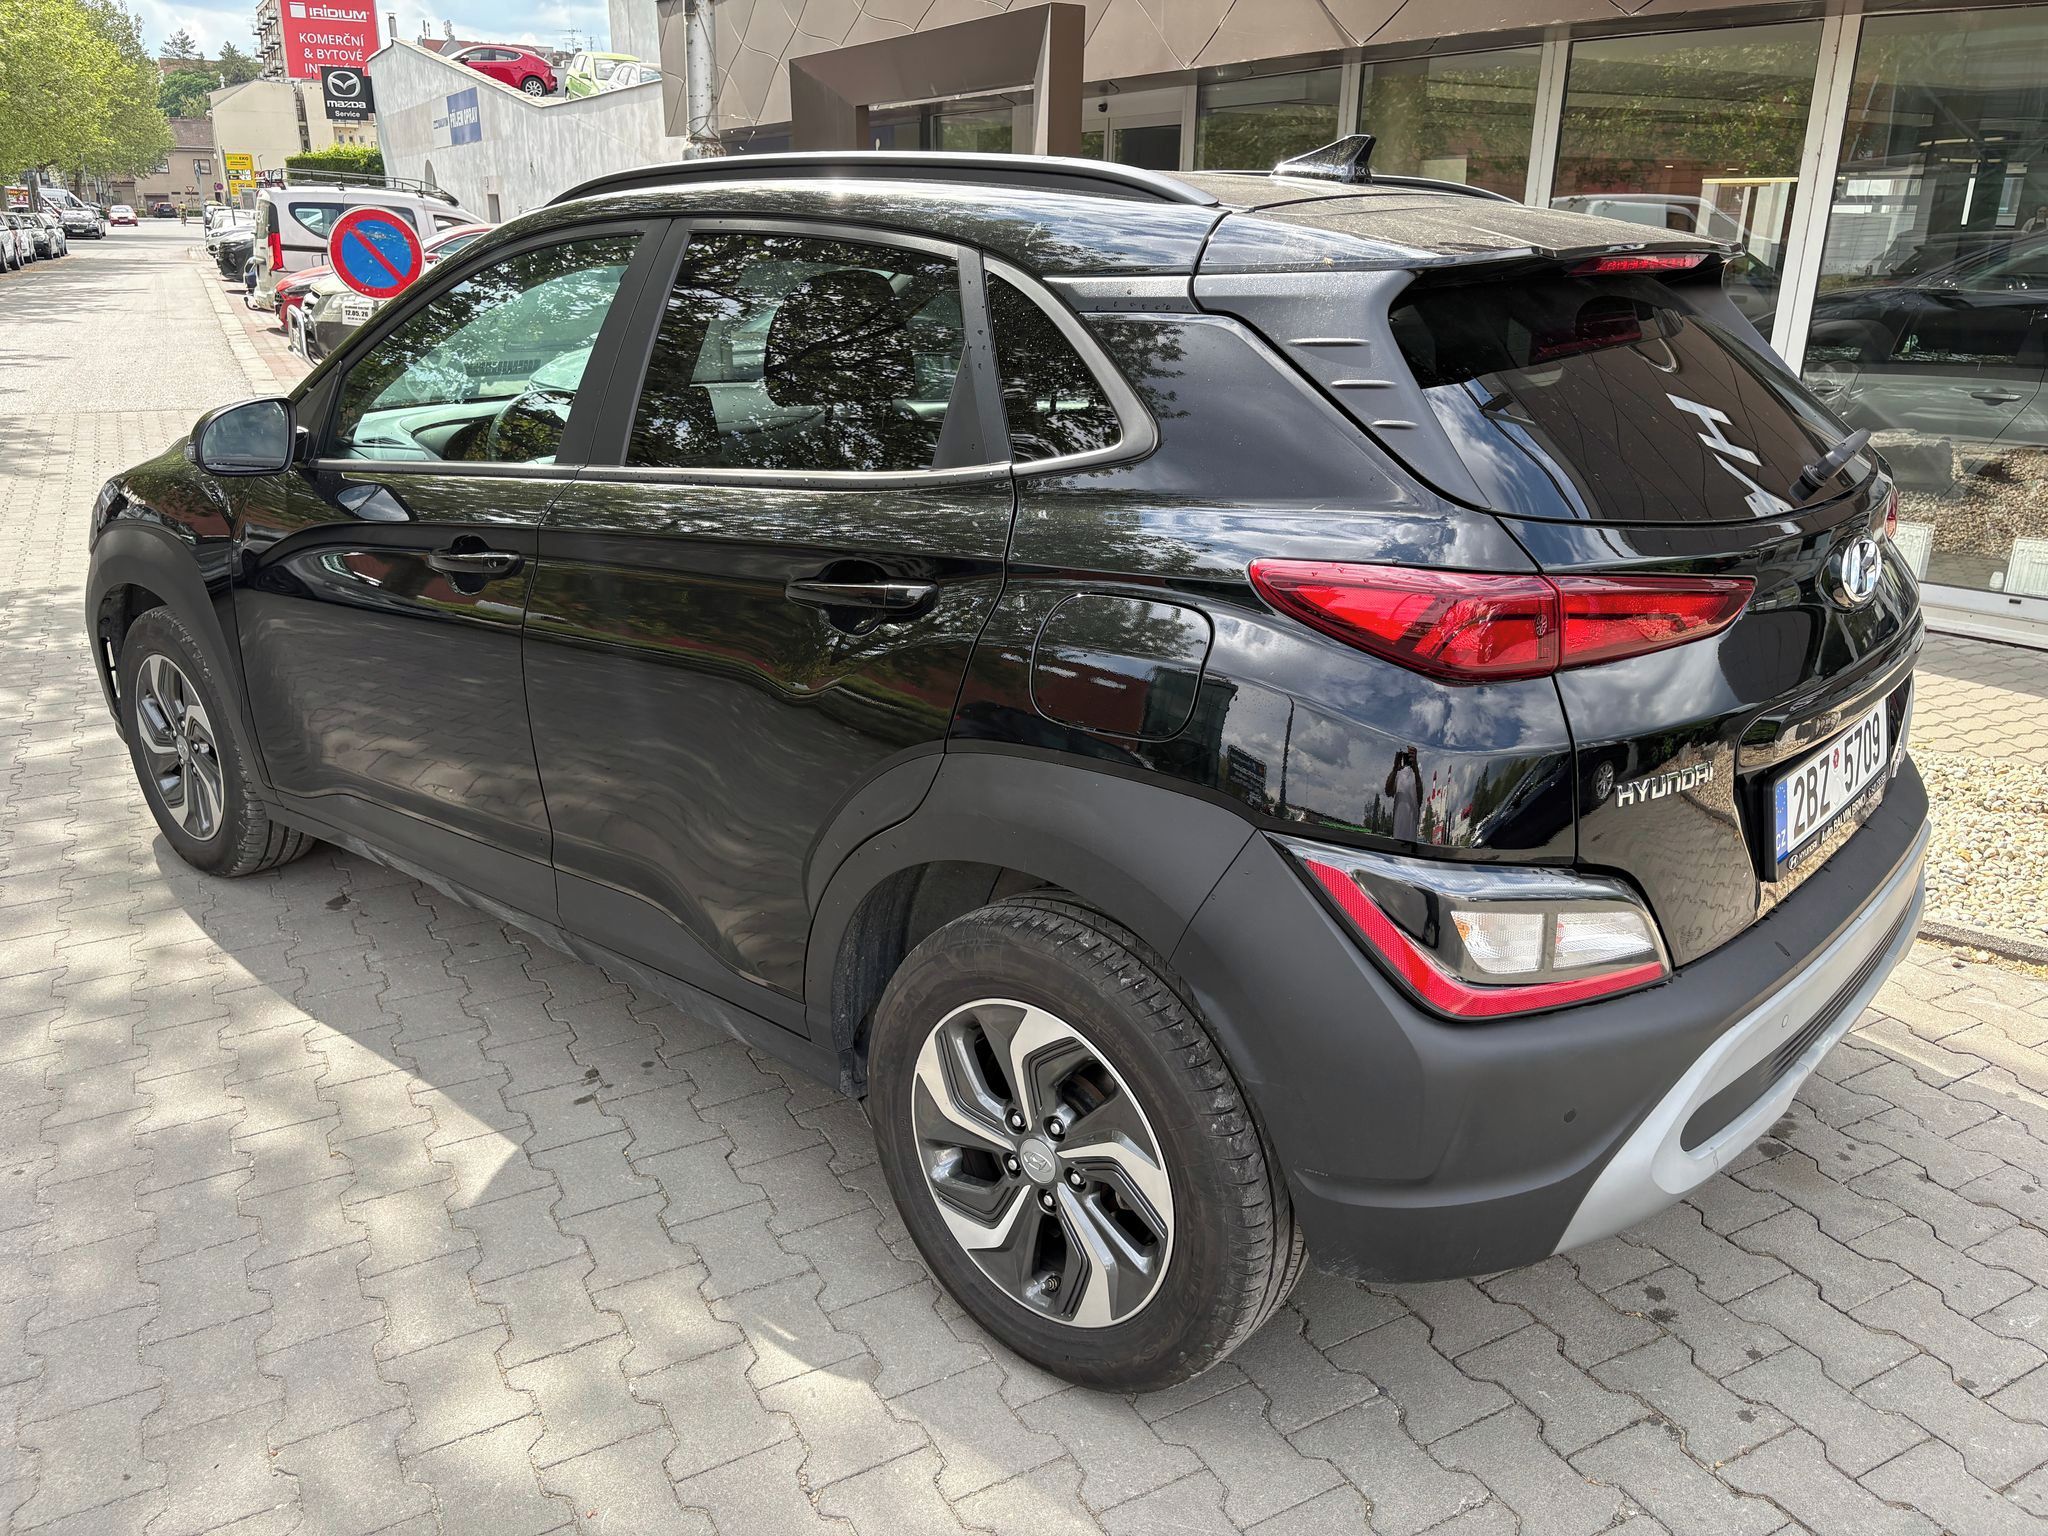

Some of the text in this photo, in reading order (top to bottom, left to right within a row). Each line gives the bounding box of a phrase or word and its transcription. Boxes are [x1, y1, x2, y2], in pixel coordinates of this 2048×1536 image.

[299, 33, 364, 46] KOMERČNÍ
[304, 48, 363, 61] & BYTOVÉ
[327, 100, 366, 109] mazda
[334, 110, 360, 118] Service
[1793, 754, 1831, 840] 2BZ
[1844, 712, 1880, 793] 5709
[1616, 760, 1714, 808] HYUNDAI
[1776, 829, 1787, 850] CZ
